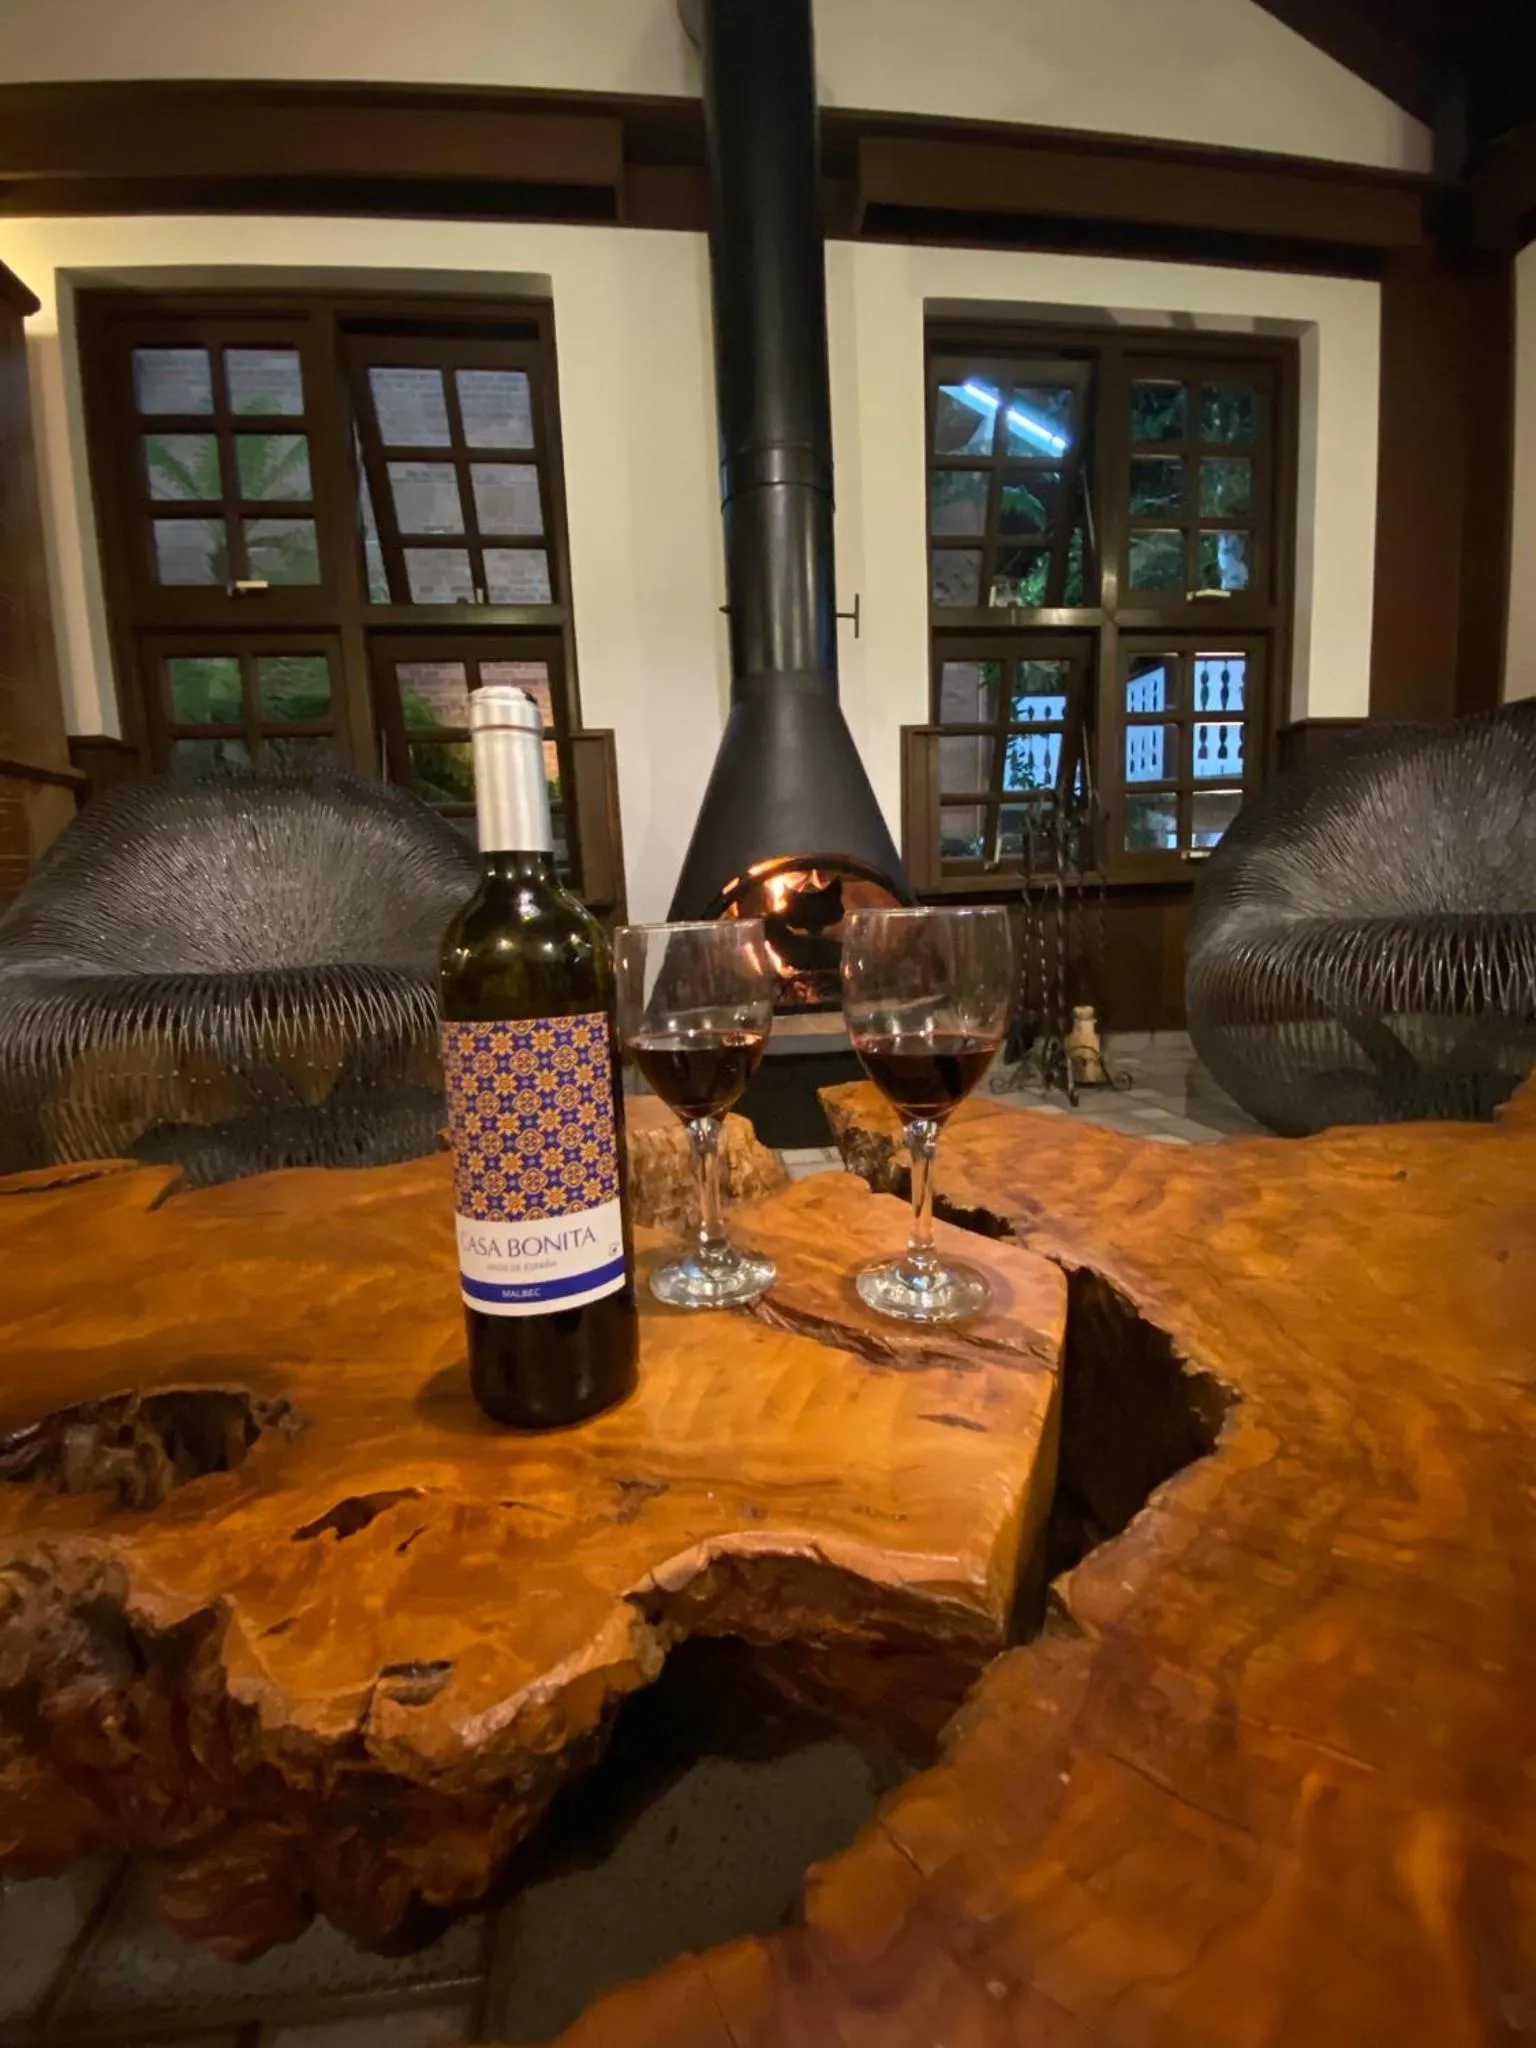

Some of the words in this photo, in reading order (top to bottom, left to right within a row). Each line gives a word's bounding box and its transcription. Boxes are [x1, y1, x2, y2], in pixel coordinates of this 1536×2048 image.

[460, 1230, 502, 1257] CASA
[507, 1226, 596, 1258] BONITA
[502, 1287, 541, 1298] MALBEC
